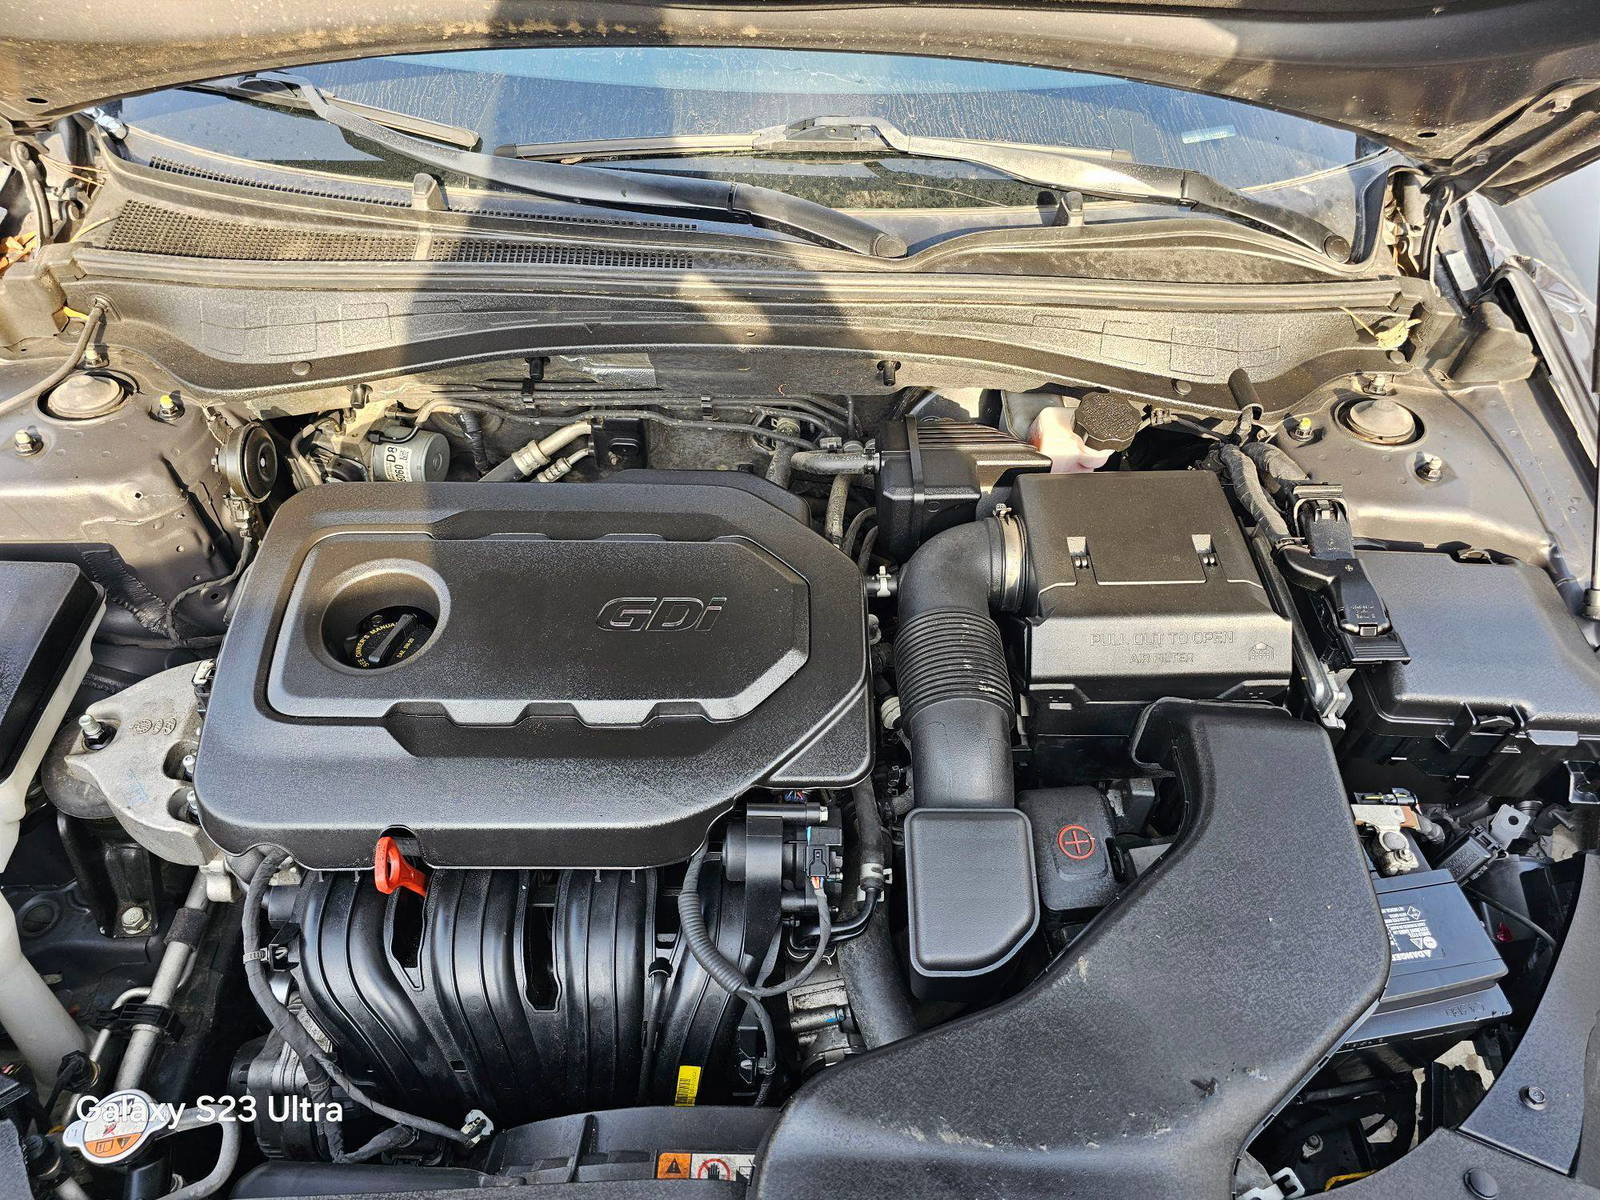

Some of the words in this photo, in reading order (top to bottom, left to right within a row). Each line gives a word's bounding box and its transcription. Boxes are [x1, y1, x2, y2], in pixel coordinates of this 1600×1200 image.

[386, 446, 398, 463] D8
[596, 597, 727, 632] GDi
[1090, 632, 1130, 647] PULL
[1132, 632, 1164, 647] OUT
[1168, 631, 1188, 645] TO
[1192, 630, 1234, 645] OPEN
